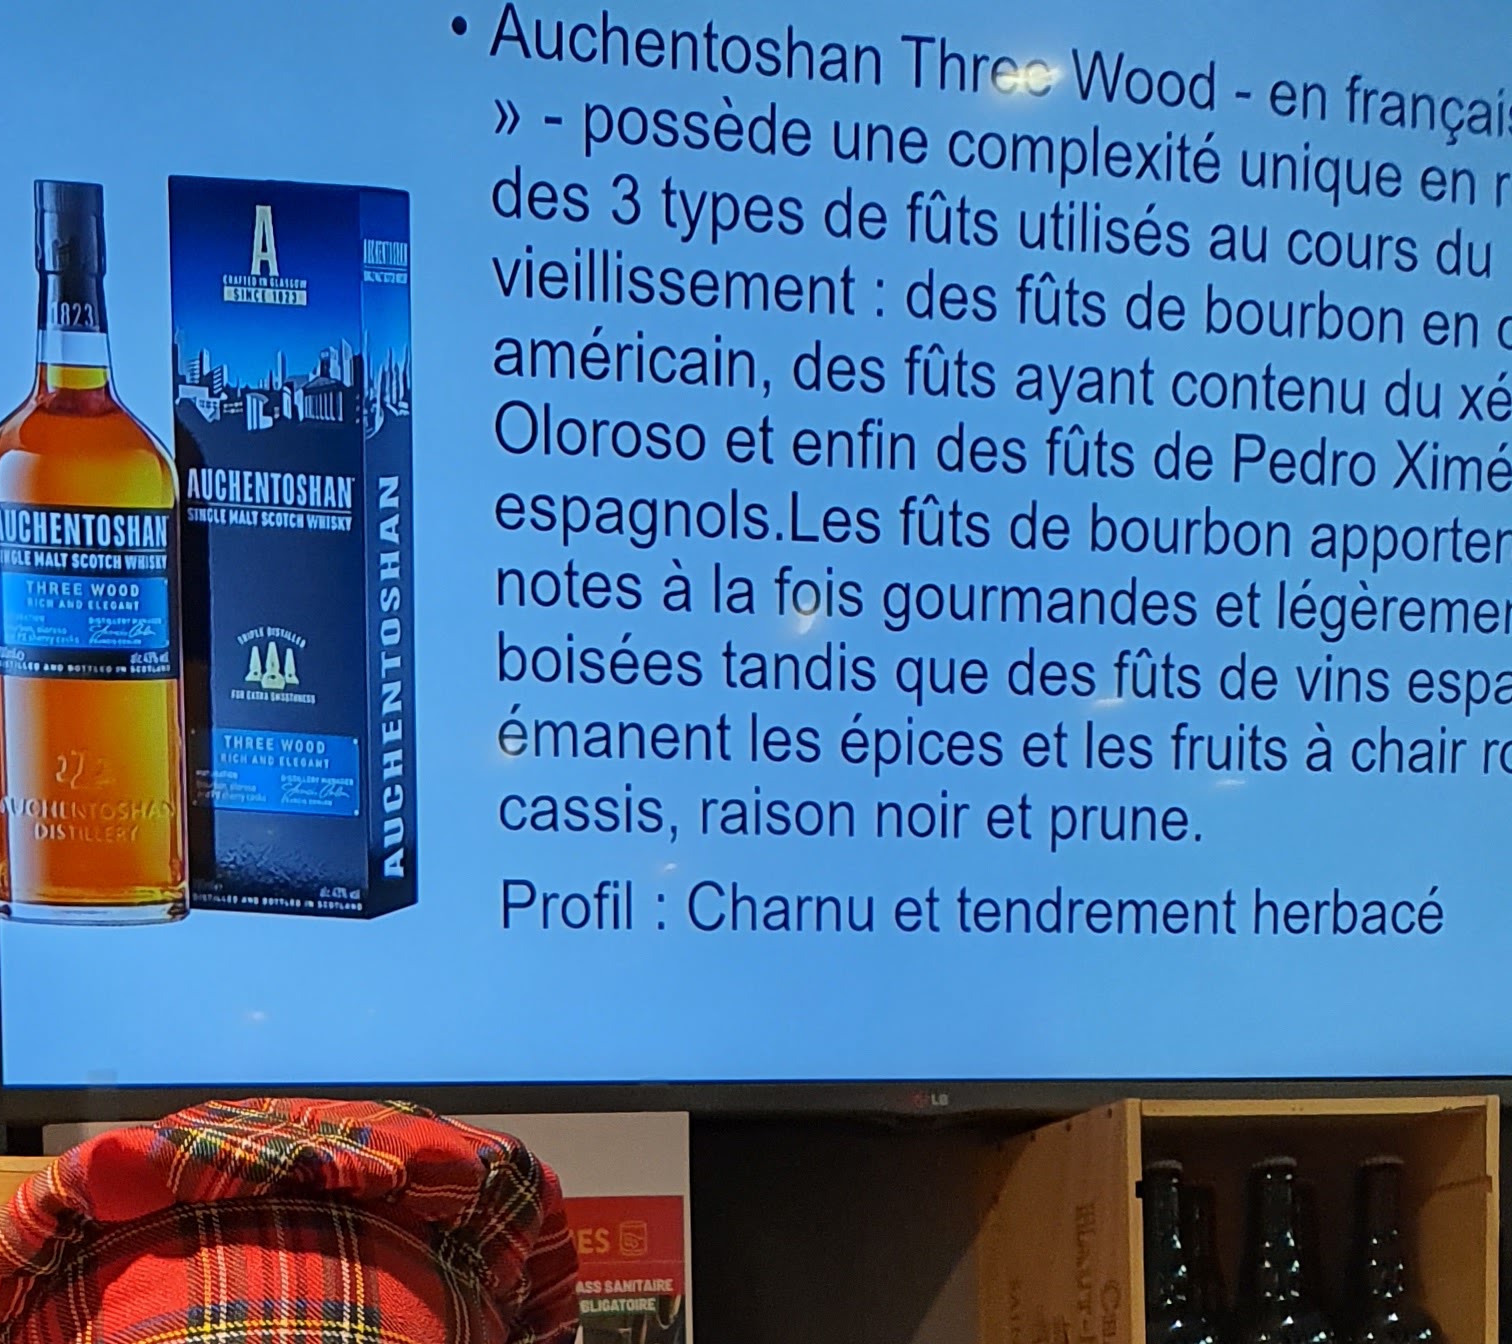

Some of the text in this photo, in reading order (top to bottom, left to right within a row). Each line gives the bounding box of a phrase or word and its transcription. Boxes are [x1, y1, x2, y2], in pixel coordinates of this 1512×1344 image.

[489, 2, 1512, 146] Auchentoshan Three Wood en françai
[584, 95, 812, 158] possède
[833, 120, 928, 165] une
[948, 124, 1221, 189] complexité
[1241, 141, 1402, 208] unique
[1420, 165, 1476, 206] en
[491, 164, 1491, 279] des 3 types de fûts utilisés au cours du
[51, 301, 94, 326] 1823
[491, 244, 856, 316] vieillissement
[906, 267, 997, 323] des
[1015, 271, 1107, 328] fûts
[1125, 279, 1186, 332] de
[1205, 283, 1404, 345] bourbon
[1422, 310, 1479, 349] en
[493, 325, 771, 399] américain,
[792, 339, 886, 394] des
[903, 342, 996, 399] fûts
[1015, 356, 1155, 416] ayant
[1171, 362, 1366, 416] contenu
[1384, 367, 1441, 419] du
[494, 399, 706, 462] Oloroso
[725, 414, 774, 465] et
[792, 417, 916, 471] enfin
[936, 421, 1027, 475] des
[1045, 423, 1135, 479] fûts
[1153, 429, 1214, 482] de
[1233, 432, 1376, 488] Pedro
[187, 467, 353, 509] AUCHENTOSHAN
[187, 507, 353, 532] SINGLE MALT SCOTCH WHISKY
[898, 493, 990, 548] fûts
[1009, 499, 1070, 551] de
[1090, 501, 1291, 558] bourbon
[26, 581, 140, 598] THREE WOOD
[34, 551, 69, 568] MALT
[71, 553, 122, 570] SCOTCH
[125, 555, 168, 570] WHISKY
[58, 599, 84, 610] AND
[88, 600, 140, 611] ELEGANT
[497, 559, 642, 610] notes
[662, 558, 692, 613] à
[714, 562, 755, 615] la
[774, 565, 864, 618] fois
[882, 575, 1198, 633] gourmandes
[1215, 581, 1261, 629] et
[378, 475, 405, 880] AUCHENTOSHAN
[498, 630, 703, 687] boisées
[721, 640, 877, 692] tandis
[895, 656, 989, 707] que
[1007, 646, 1096, 697] des
[1113, 647, 1202, 700] fûts
[1219, 651, 1278, 701] de
[1295, 653, 1390, 703] vins
[220, 753, 330, 769] RICH AND ELEGANT
[223, 734, 326, 754] THREE WOOD
[497, 703, 1468, 778] émanent les épices et les fruits à chair
[34, 823, 140, 842] DISTILLERY
[499, 782, 1202, 853] cassis, raison noir et prune.
[502, 879, 1444, 935] Profil Charnu et tendrement herbacé
[575, 1278, 674, 1294] ASS SANITAIRE
[579, 1298, 657, 1314] BLIGATOIRE
